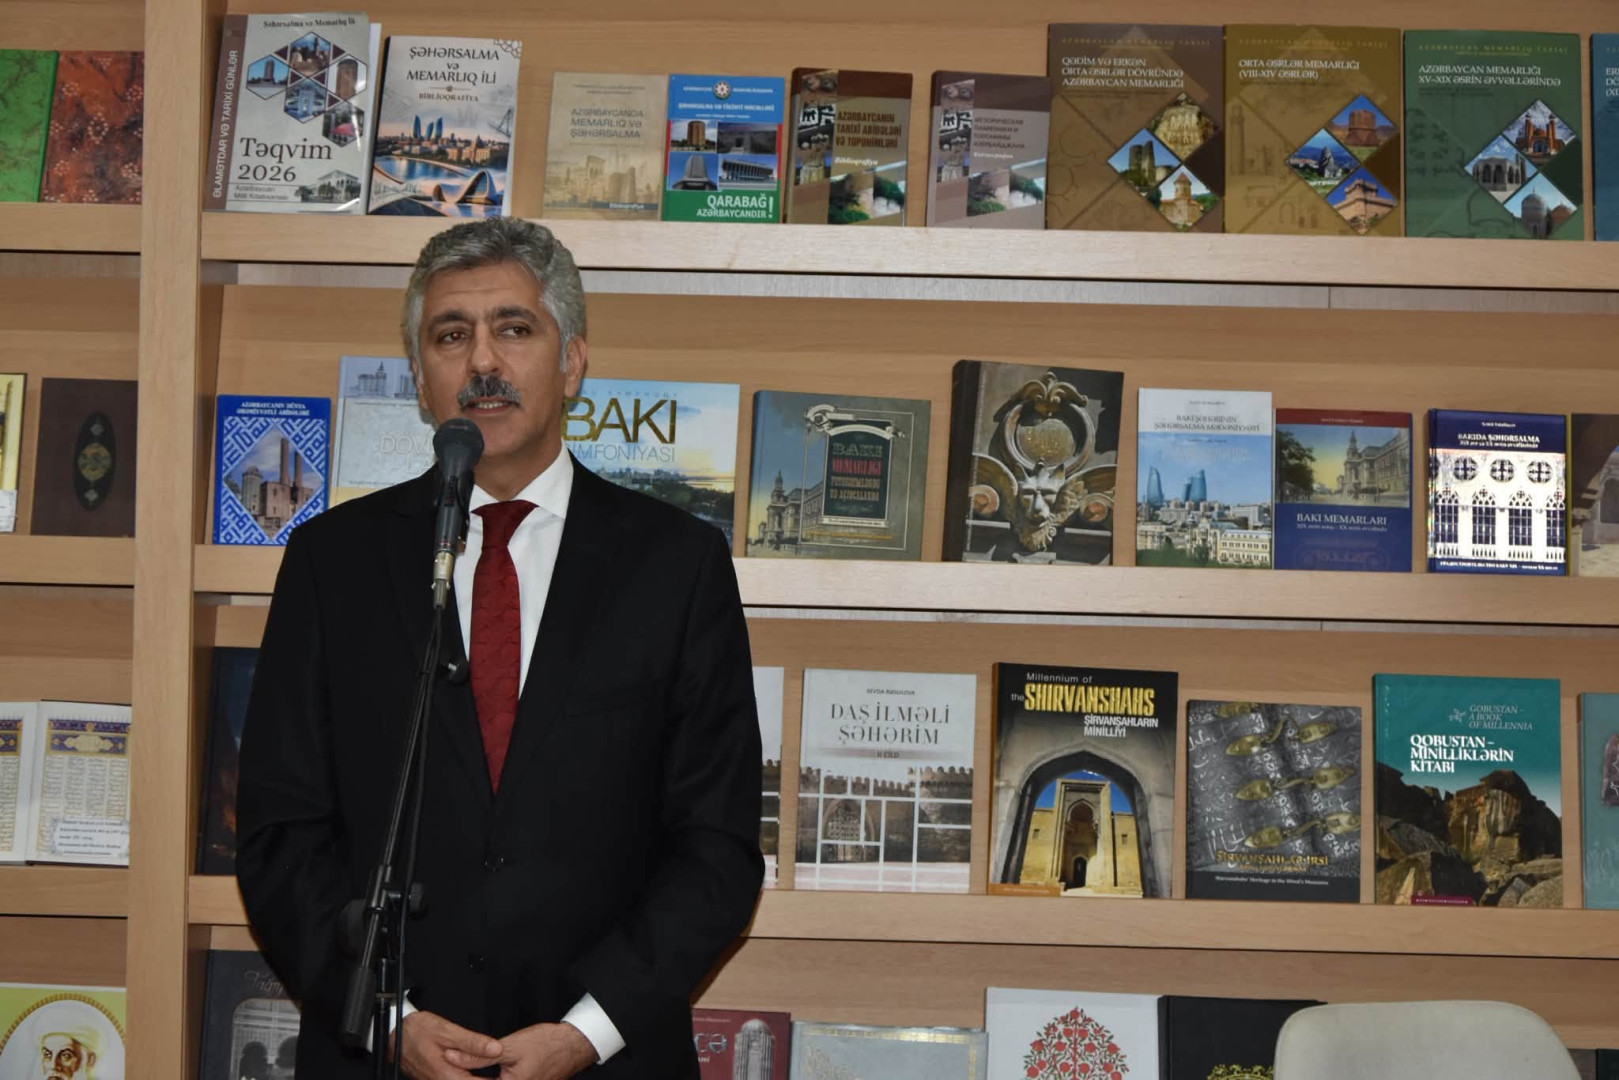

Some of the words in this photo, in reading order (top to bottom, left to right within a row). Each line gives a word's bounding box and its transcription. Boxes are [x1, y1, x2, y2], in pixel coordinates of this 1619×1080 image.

[409, 46, 500, 60] ŞƏHƏRSALMA
[1062, 56, 1095, 66] QƏDİM
[1098, 58, 1111, 66] VƏ
[1114, 58, 1146, 67] ERKƏN
[1239, 58, 1264, 68] ORTA
[1266, 60, 1303, 68] ƏSRLƏR
[1305, 60, 1360, 70] MEMARLIĞI
[226, 51, 238, 90] GÜNLƏR
[1062, 67, 1087, 76] ORTA
[1088, 68, 1126, 76] ƏSRLƏR
[1128, 68, 1184, 78] DÖVRÜNDƏ
[1278, 70, 1318, 80] ƏSRLƏR)
[1418, 65, 1484, 74] AZƏRBAYCAN
[1486, 64, 1540, 76] MEMARLIĞI
[406, 70, 478, 86] MEMARLIQ
[481, 70, 496, 84] İLİ
[1062, 78, 1127, 87] AZƏRBAYCAN
[1129, 78, 1184, 88] MEMARLIĞI
[1453, 74, 1482, 84] ƏSRİN
[1484, 76, 1561, 86] ƏVVƏLLƏRİNDƏ
[572, 108, 644, 118] AZƏRBAYCANDA
[570, 118, 626, 128] MEMARLIQ
[628, 120, 642, 128] VƏ
[837, 123, 860, 134] TARİXİ
[862, 124, 902, 137] ABİDƏLƏRİ
[220, 124, 230, 138] VƏ
[570, 128, 641, 139] ŞƏHƏRSALMA
[240, 138, 332, 164] Təqvim
[213, 139, 228, 198] ƏLAMƏTDAR
[238, 164, 296, 182] 2026
[707, 192, 766, 208] QARABAĞ
[696, 208, 766, 218] AZƏRBAYCANDIR
[562, 396, 677, 444] BAKI
[1458, 433, 1486, 441] BAKIDA
[1488, 434, 1540, 443] ŞƏHƏRSALMA
[1296, 512, 1322, 522] BAKI
[1324, 514, 1387, 526] MEMARLARI
[1026, 672, 1078, 683] Millennium
[1082, 675, 1092, 684] of
[1011, 693, 1024, 702] the
[1024, 683, 1155, 716] SHIRVANSHAHS
[831, 703, 870, 724] DAŞ
[876, 702, 950, 724] İLMƏLİ
[1470, 704, 1518, 714] GOBUSTAN
[1084, 714, 1158, 728] ŞİRVANŞAHLARIN
[1476, 714, 1502, 722] BOOK
[1084, 726, 1126, 738] MİNİLLİYİ
[1469, 721, 1480, 729] OF
[1482, 721, 1533, 731] MILLENNIA
[838, 724, 939, 744] ŞƏHƏRİM
[1410, 734, 1486, 748] QOBUSTAN
[1410, 746, 1514, 762] MİNİLLİKLƏRİN
[1411, 758, 1454, 773] KİTABI
